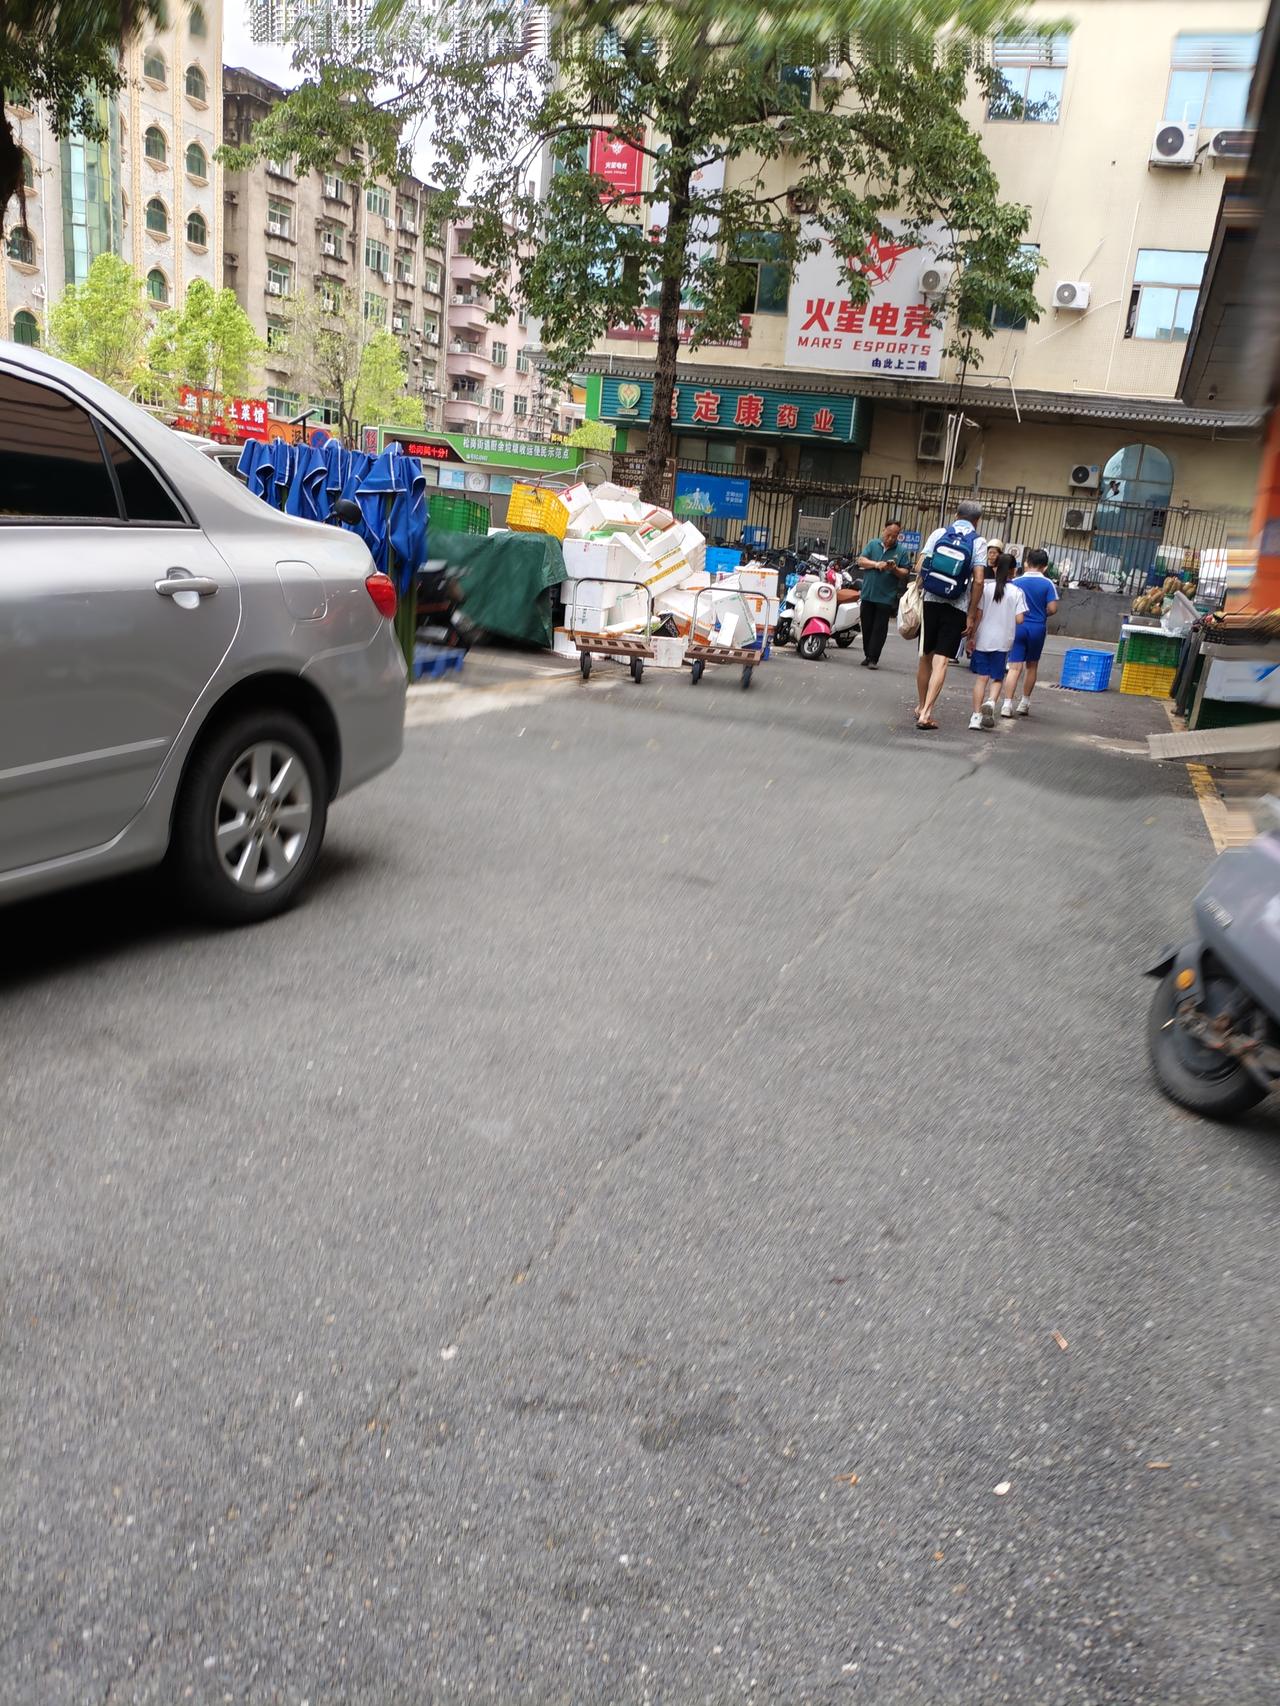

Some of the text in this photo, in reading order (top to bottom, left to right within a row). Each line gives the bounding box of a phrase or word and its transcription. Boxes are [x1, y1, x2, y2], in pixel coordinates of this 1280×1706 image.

[800, 298, 932, 339] 火星电竞
[798, 335, 932, 356] MARS ESPORTS
[671, 388, 835, 433] 定康药业
